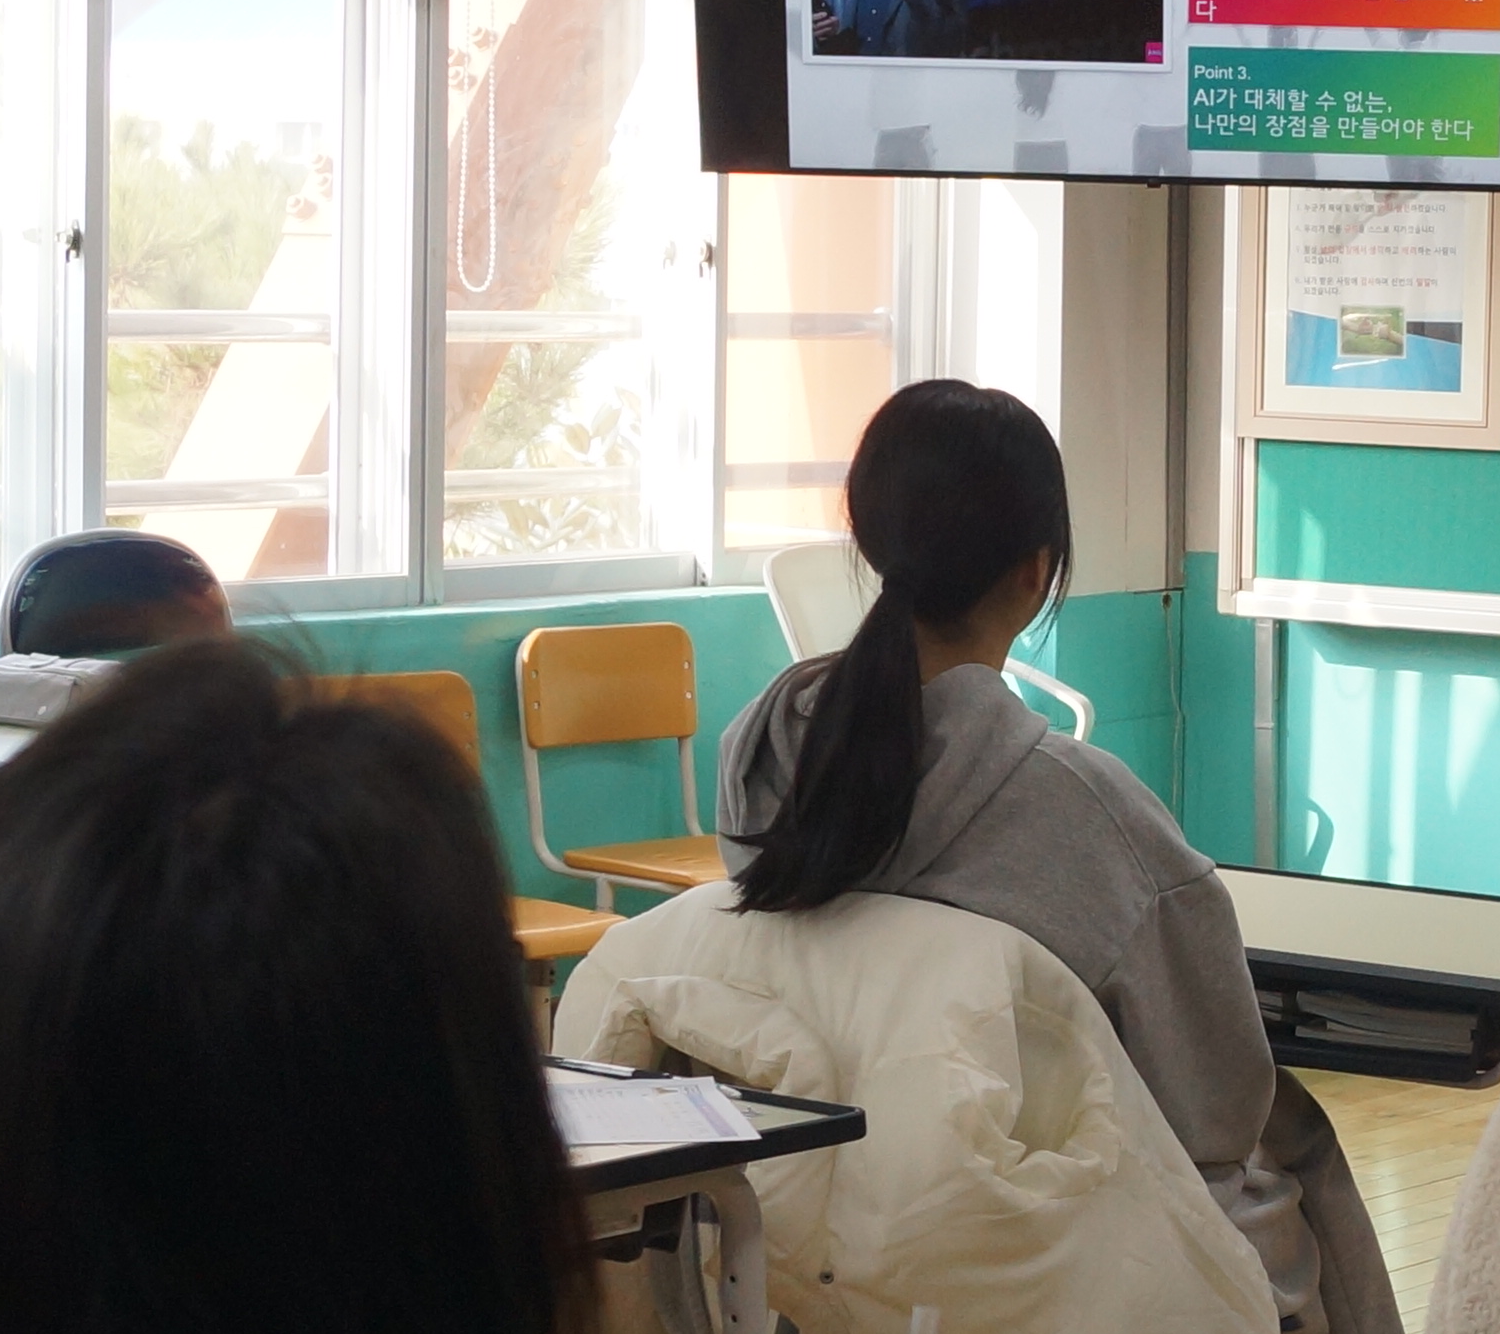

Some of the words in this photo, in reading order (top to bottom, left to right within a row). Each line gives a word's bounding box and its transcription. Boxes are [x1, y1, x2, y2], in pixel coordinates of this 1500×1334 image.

[1196, 0, 1217, 22] 다
[1194, 65, 1234, 80] Point
[1237, 65, 1252, 81] 3.
[1193, 87, 1237, 110] AI가
[1244, 88, 1309, 112] 대체할
[1315, 91, 1338, 112] 수
[1343, 91, 1393, 114] 없는,
[1194, 112, 1258, 136] 나만의
[1265, 115, 1331, 139] 장점을
[1338, 116, 1425, 141] 만들어야
[1431, 118, 1474, 141] 한다
